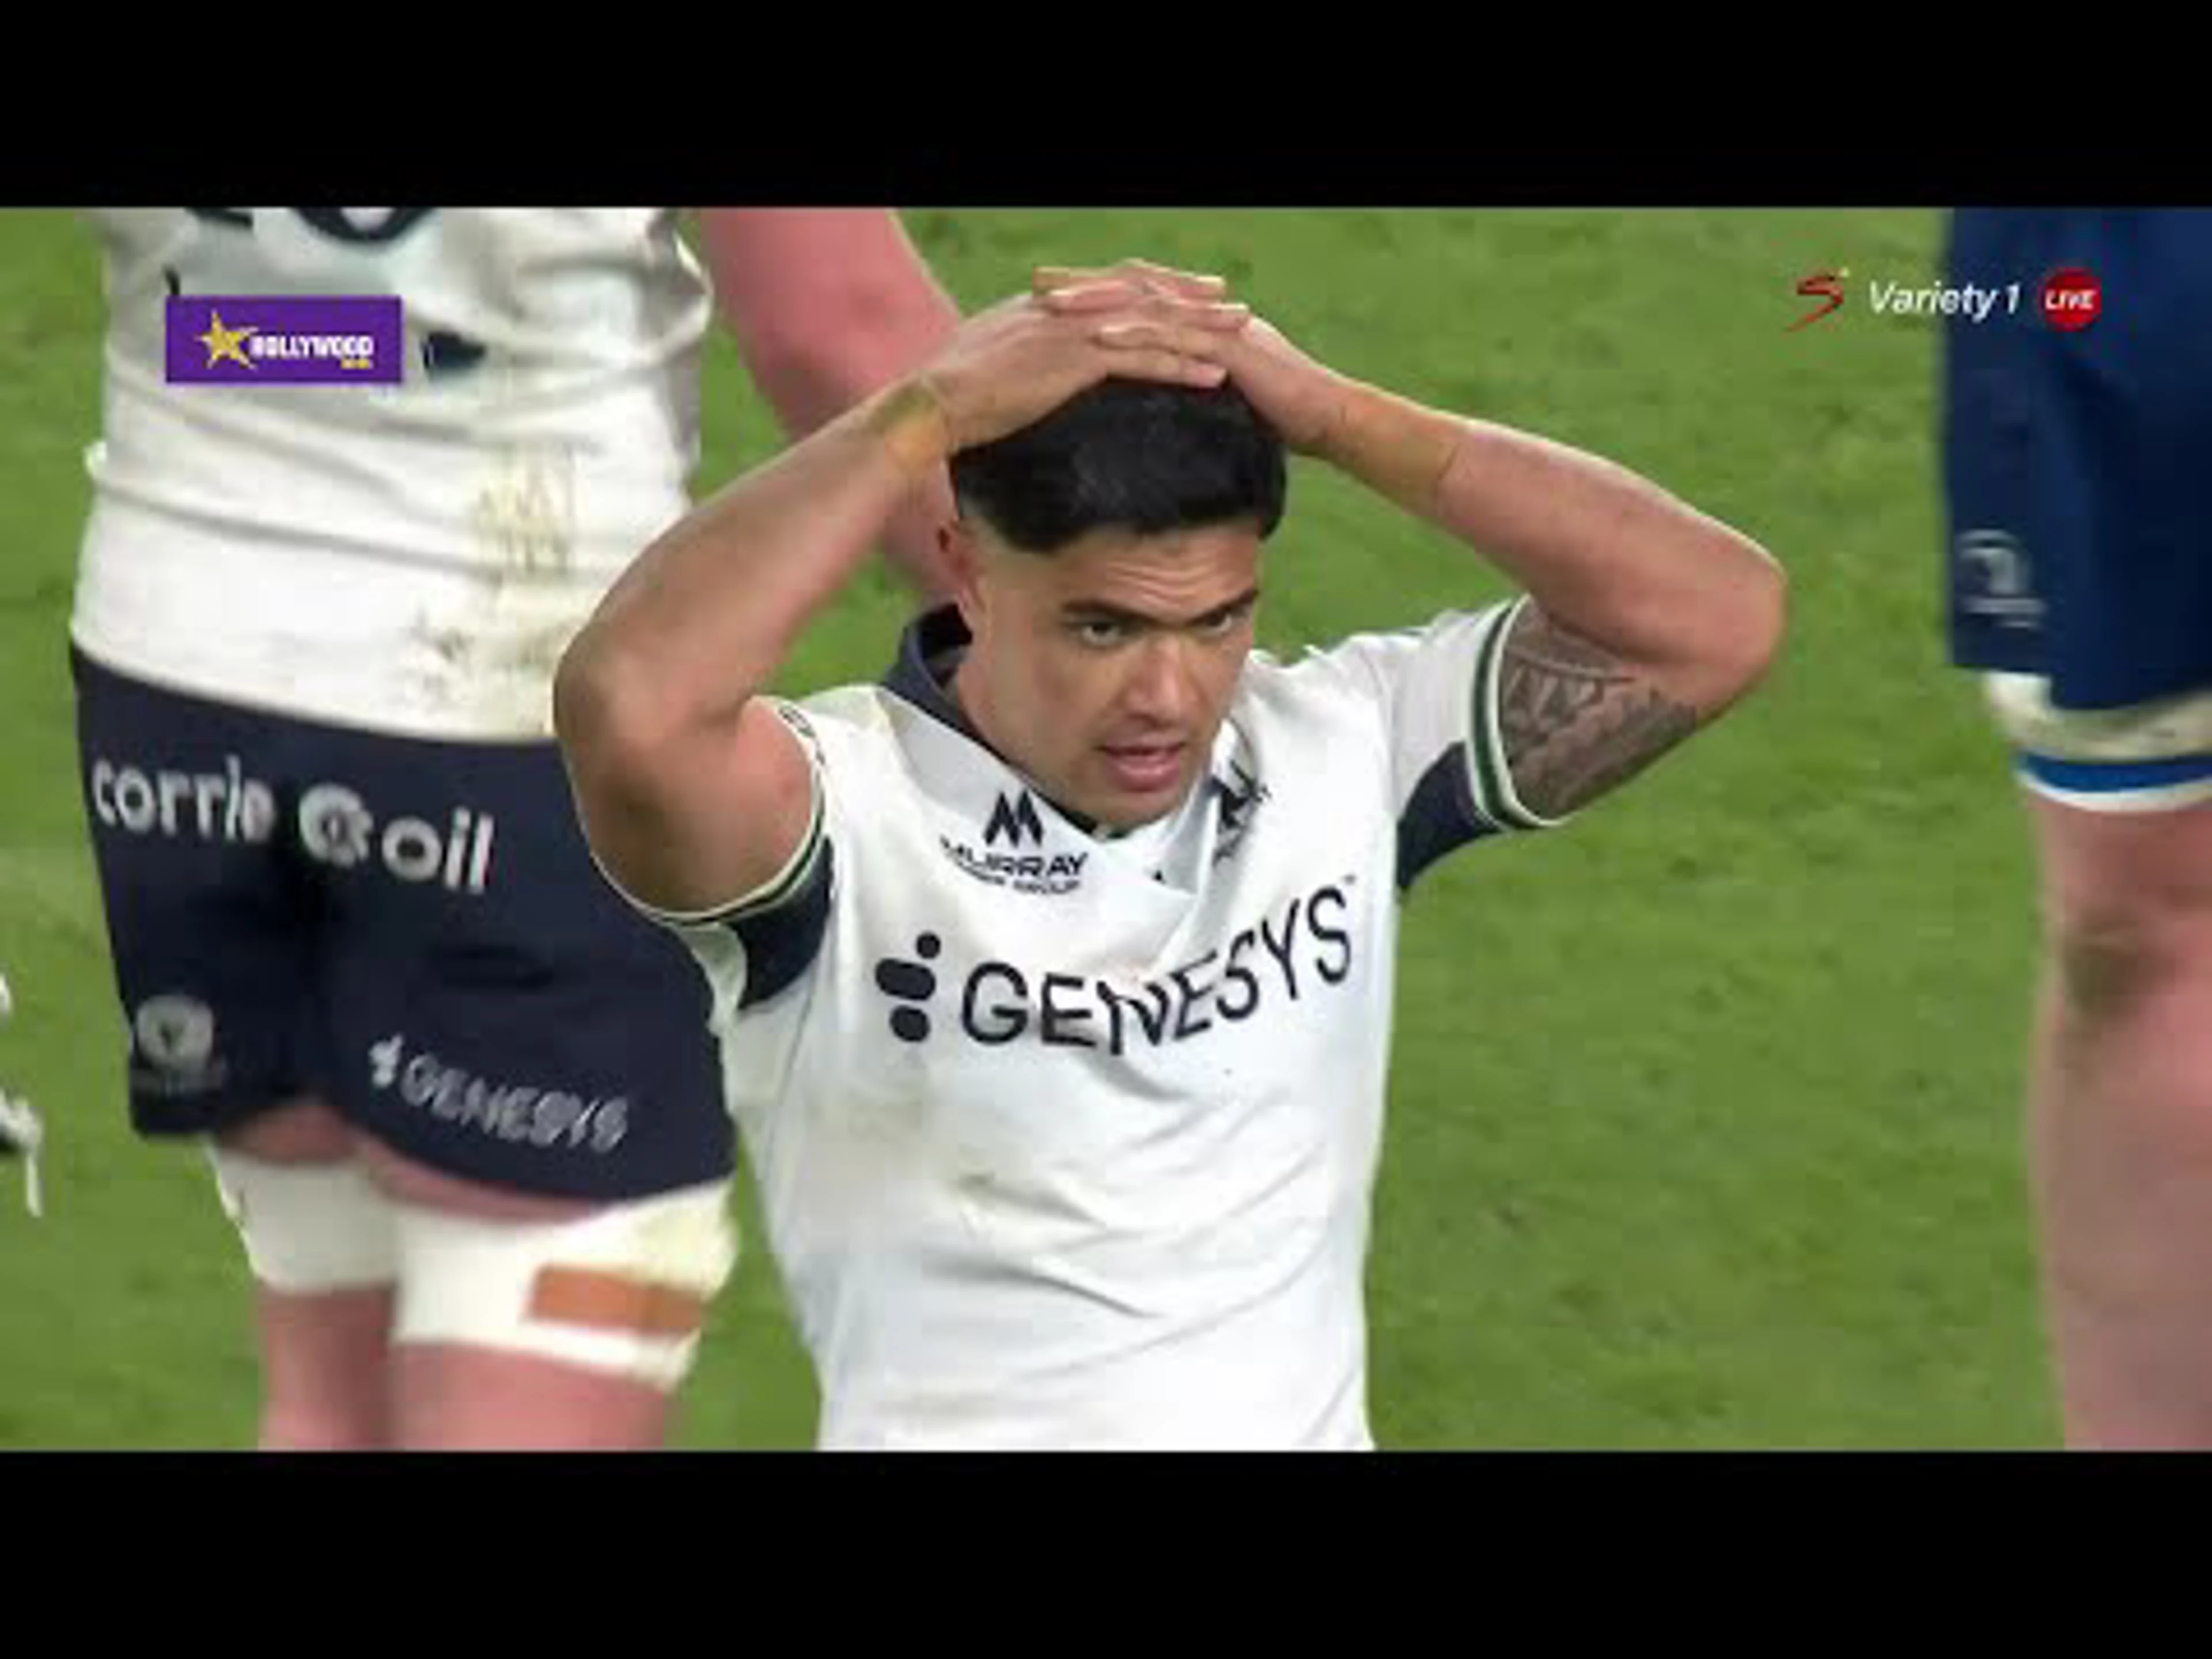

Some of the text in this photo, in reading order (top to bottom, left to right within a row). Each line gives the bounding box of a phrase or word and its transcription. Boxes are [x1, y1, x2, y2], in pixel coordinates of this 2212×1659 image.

[382, 806, 494, 894] oil
[940, 835, 1089, 876] MURRAY
[962, 887, 1353, 1055] GENESYS
[401, 1054, 628, 1153] GENESYS
